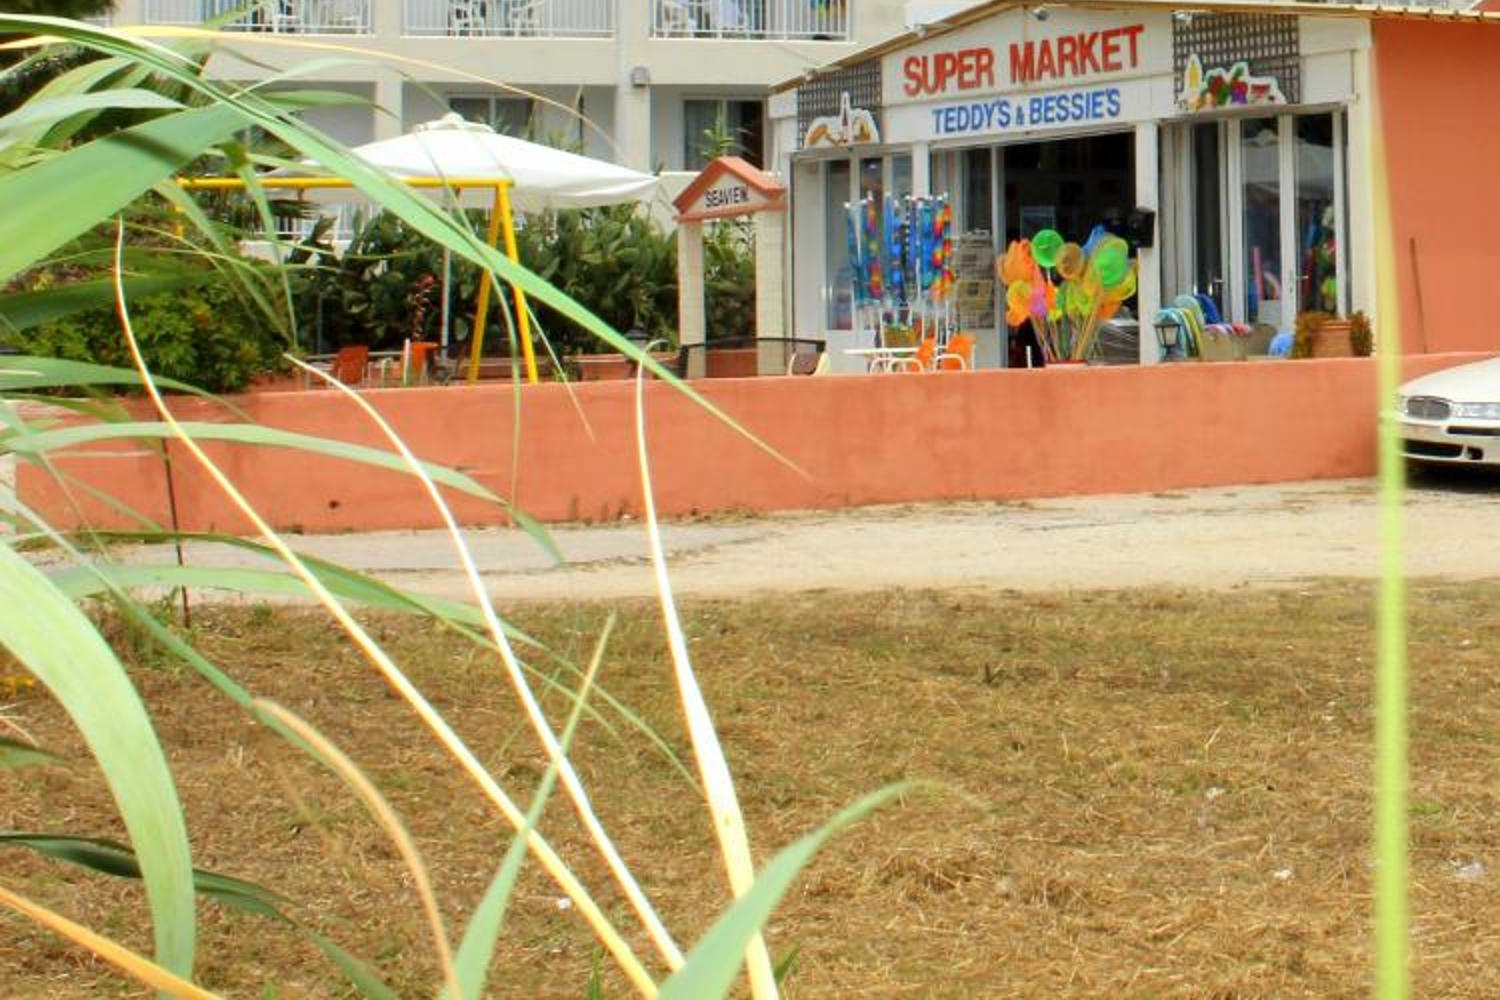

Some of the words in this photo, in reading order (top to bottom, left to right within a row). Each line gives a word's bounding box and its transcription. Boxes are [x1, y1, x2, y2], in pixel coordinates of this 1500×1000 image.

[903, 46, 995, 97] SUPER
[1009, 24, 1144, 84] MARKET
[932, 100, 1012, 134] TEDDY'S
[1016, 106, 1025, 126] &
[1029, 88, 1121, 125] BESSIE'S
